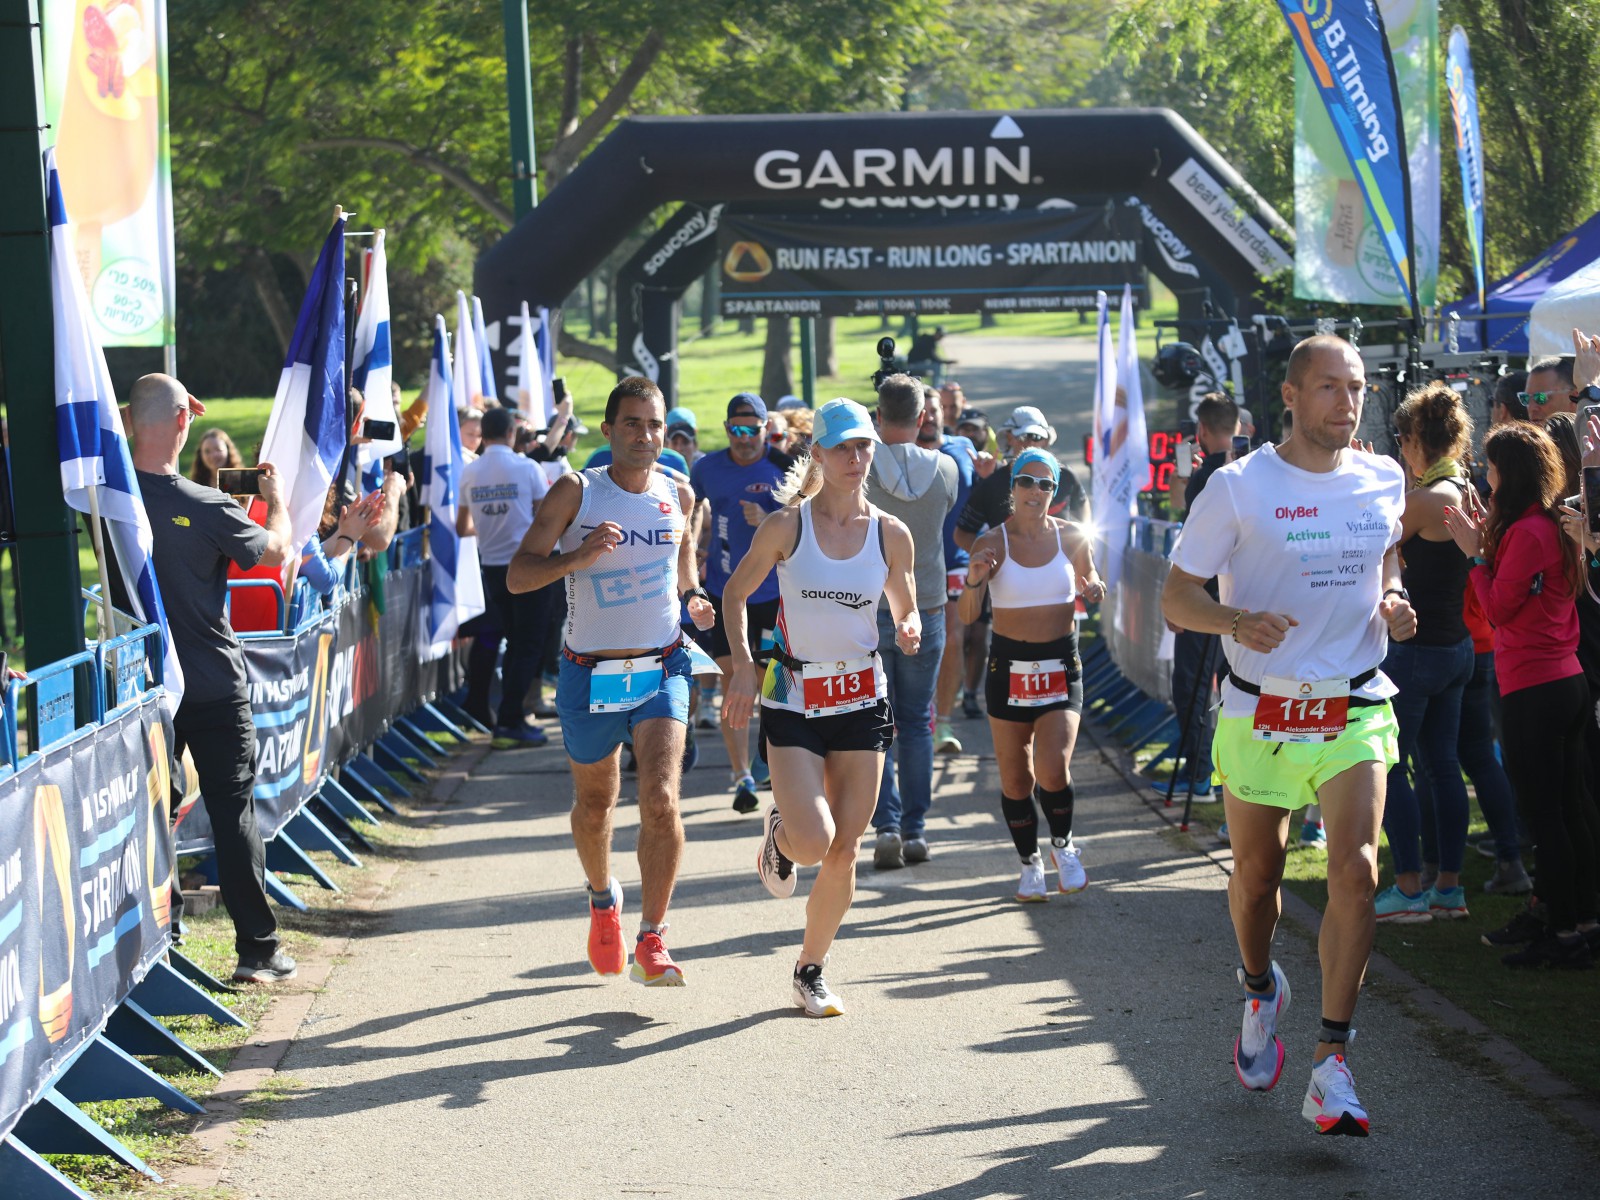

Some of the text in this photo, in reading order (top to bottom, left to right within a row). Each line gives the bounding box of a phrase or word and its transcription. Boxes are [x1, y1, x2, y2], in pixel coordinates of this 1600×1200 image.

[1323, 19, 1389, 163] B.Timing
[753, 145, 1031, 190] GARMIN
[1124, 195, 1192, 261] saucony
[1185, 171, 1278, 266] beat yesterday
[643, 210, 706, 277] saucony
[776, 248, 820, 270] RUN
[823, 247, 873, 269] FAST
[888, 246, 933, 269] RUN
[934, 243, 992, 267] LONG
[1006, 240, 1136, 266] SPARTANION
[725, 299, 821, 314] SPARTANION
[1275, 506, 1319, 521] OlyBet
[1286, 529, 1331, 542] Activus
[1346, 521, 1389, 534] Vytautas
[1310, 579, 1357, 588] BNM Finance
[801, 589, 862, 603] saucony
[621, 673, 632, 693] 1
[822, 673, 861, 697] 113
[1021, 673, 1050, 692] 111
[1280, 698, 1327, 721] 114
